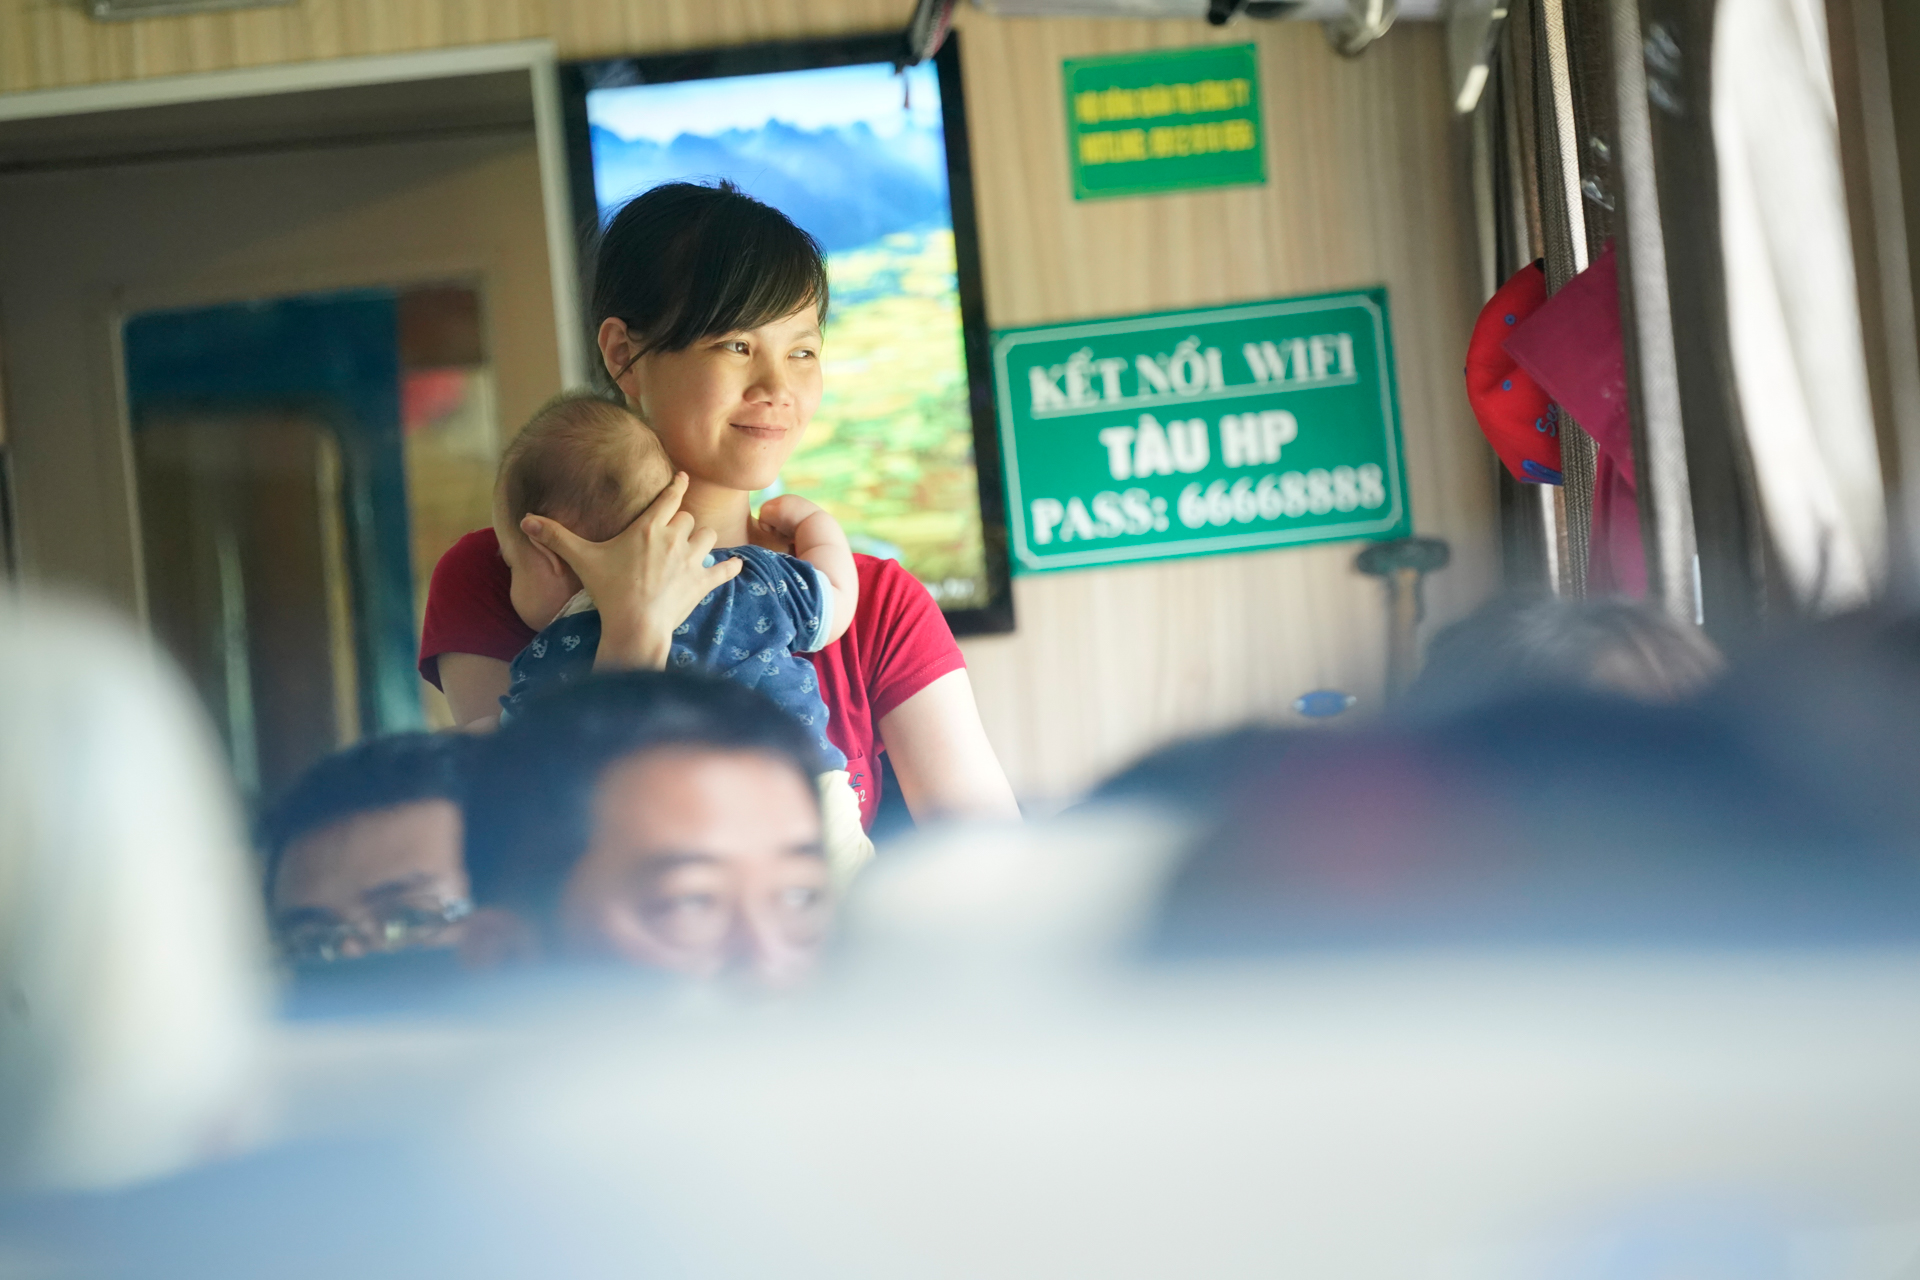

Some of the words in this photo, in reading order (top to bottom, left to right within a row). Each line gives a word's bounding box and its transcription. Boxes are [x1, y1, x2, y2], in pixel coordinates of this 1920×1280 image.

[1028, 346, 1127, 411] KẾT
[1135, 335, 1224, 400] NỐI
[1243, 332, 1356, 386] WIFI
[1098, 413, 1210, 480] TÀU
[1218, 409, 1298, 468] HP
[1030, 487, 1169, 545] PASS:
[1177, 463, 1385, 529] 66668888
